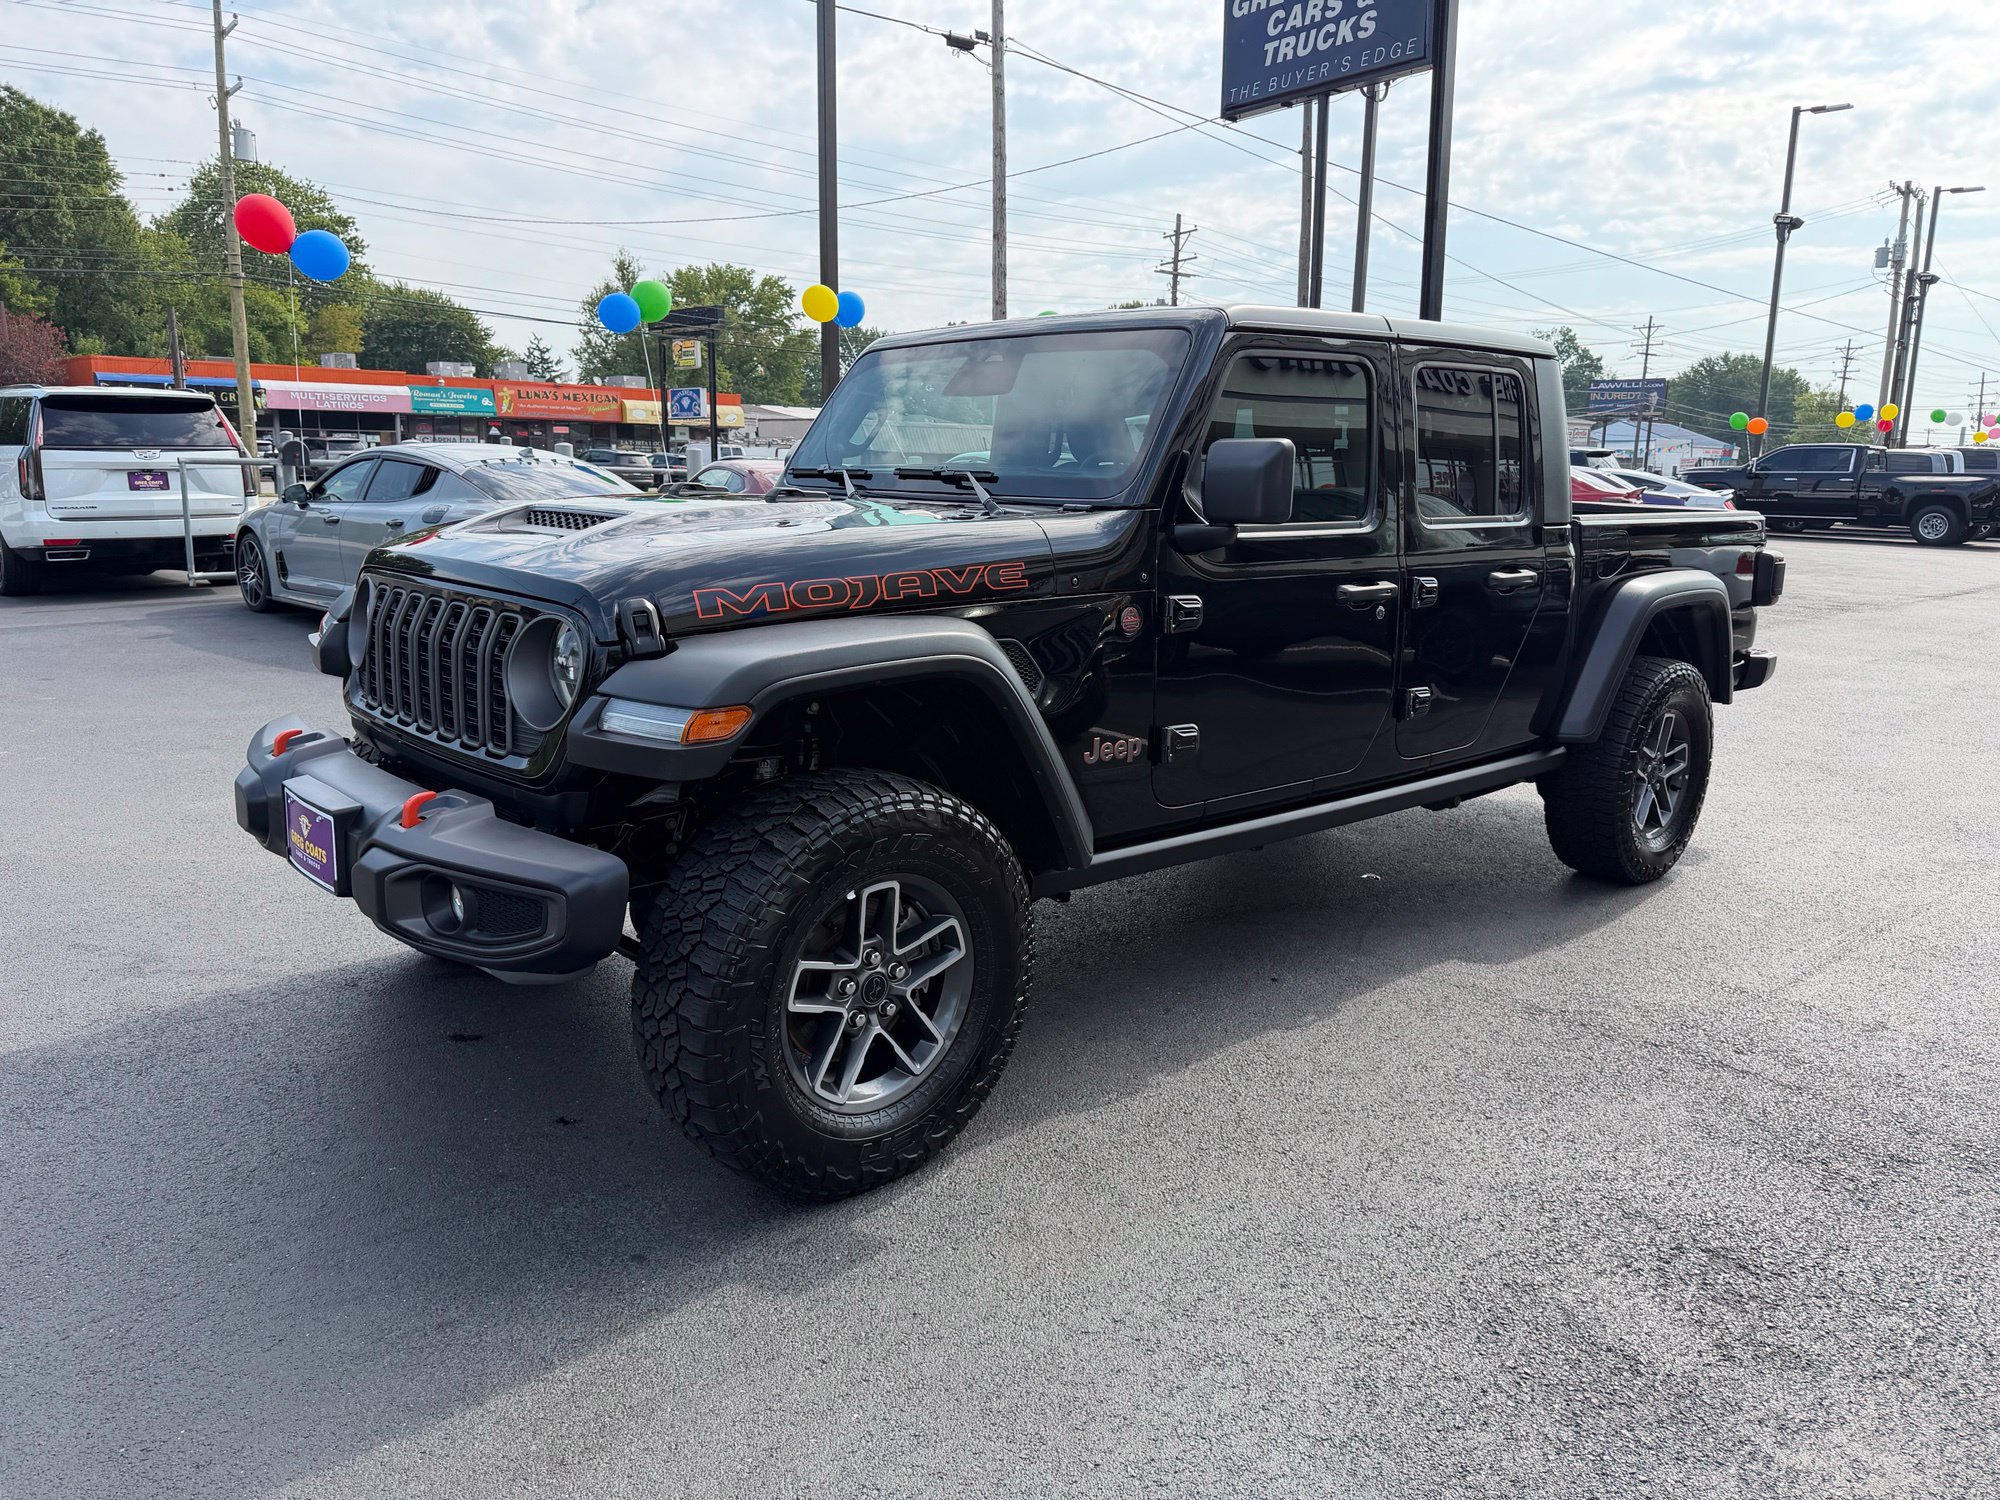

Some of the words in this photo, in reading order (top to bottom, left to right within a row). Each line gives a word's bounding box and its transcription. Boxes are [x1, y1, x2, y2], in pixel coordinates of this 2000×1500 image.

[1266, 0, 1343, 37] CARS
[1263, 9, 1378, 67] TRUCKS
[1230, 81, 1262, 103] THE
[1268, 56, 1352, 92] BUYER'S
[1360, 37, 1417, 67] EDGE
[290, 391, 388, 402] MULTI-SERVICIOS
[316, 400, 365, 409] LATINOS
[412, 389, 446, 398] Roman's
[447, 391, 478, 400] Jewelry
[517, 389, 559, 400] LUNA'S
[562, 392, 619, 404] MEXICAN
[1590, 391, 1641, 400] INJURED?
[692, 562, 1029, 619] MOJAVE
[1083, 737, 1142, 764] Jeep
[291, 829, 304, 850] GREG
[305, 840, 327, 864] COATS
